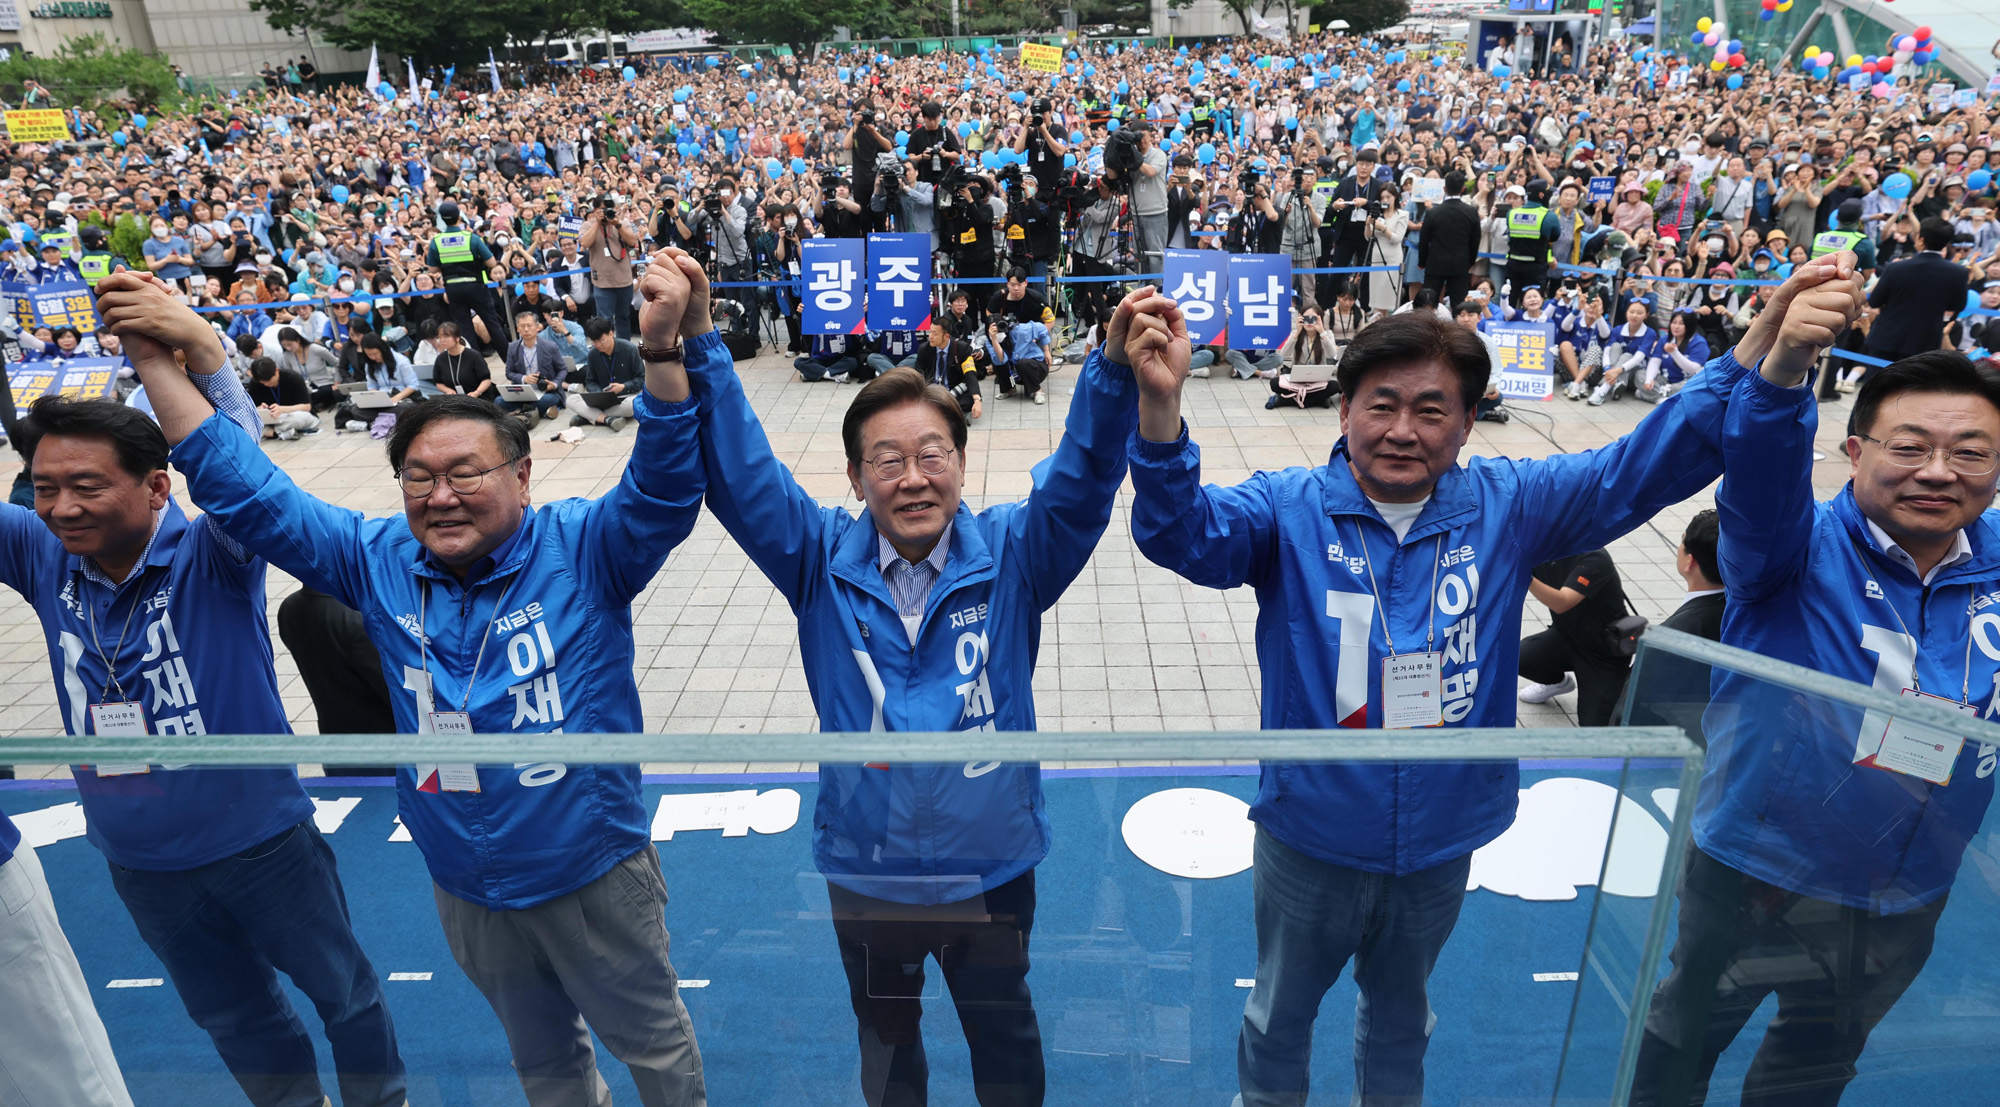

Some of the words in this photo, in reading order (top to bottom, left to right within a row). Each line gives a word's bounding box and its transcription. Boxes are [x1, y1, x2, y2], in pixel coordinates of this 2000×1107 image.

[809, 260, 857, 311] 광
[875, 257, 923, 307] 주
[37, 299, 66, 315] 6월
[65, 295, 93, 311] 3일
[1170, 271, 1216, 322] 성
[1239, 275, 1285, 326] 남
[1492, 334, 1517, 347] 6월
[1520, 335, 1546, 349] 3일
[1498, 346, 1546, 370] 투표
[62, 372, 87, 386] 6월
[86, 371, 111, 385] 3일
[1500, 379, 1546, 395] 이재명
[494, 602, 544, 635] 지금은
[949, 603, 988, 629] 지금은
[1437, 562, 1480, 723] 이재명
[1326, 589, 1375, 725] 1
[1391, 662, 1433, 673] 선거사무원
[100, 711, 136, 721] 선거사무원
[403, 665, 438, 790] 1
[438, 722, 466, 730] 선거사무원
